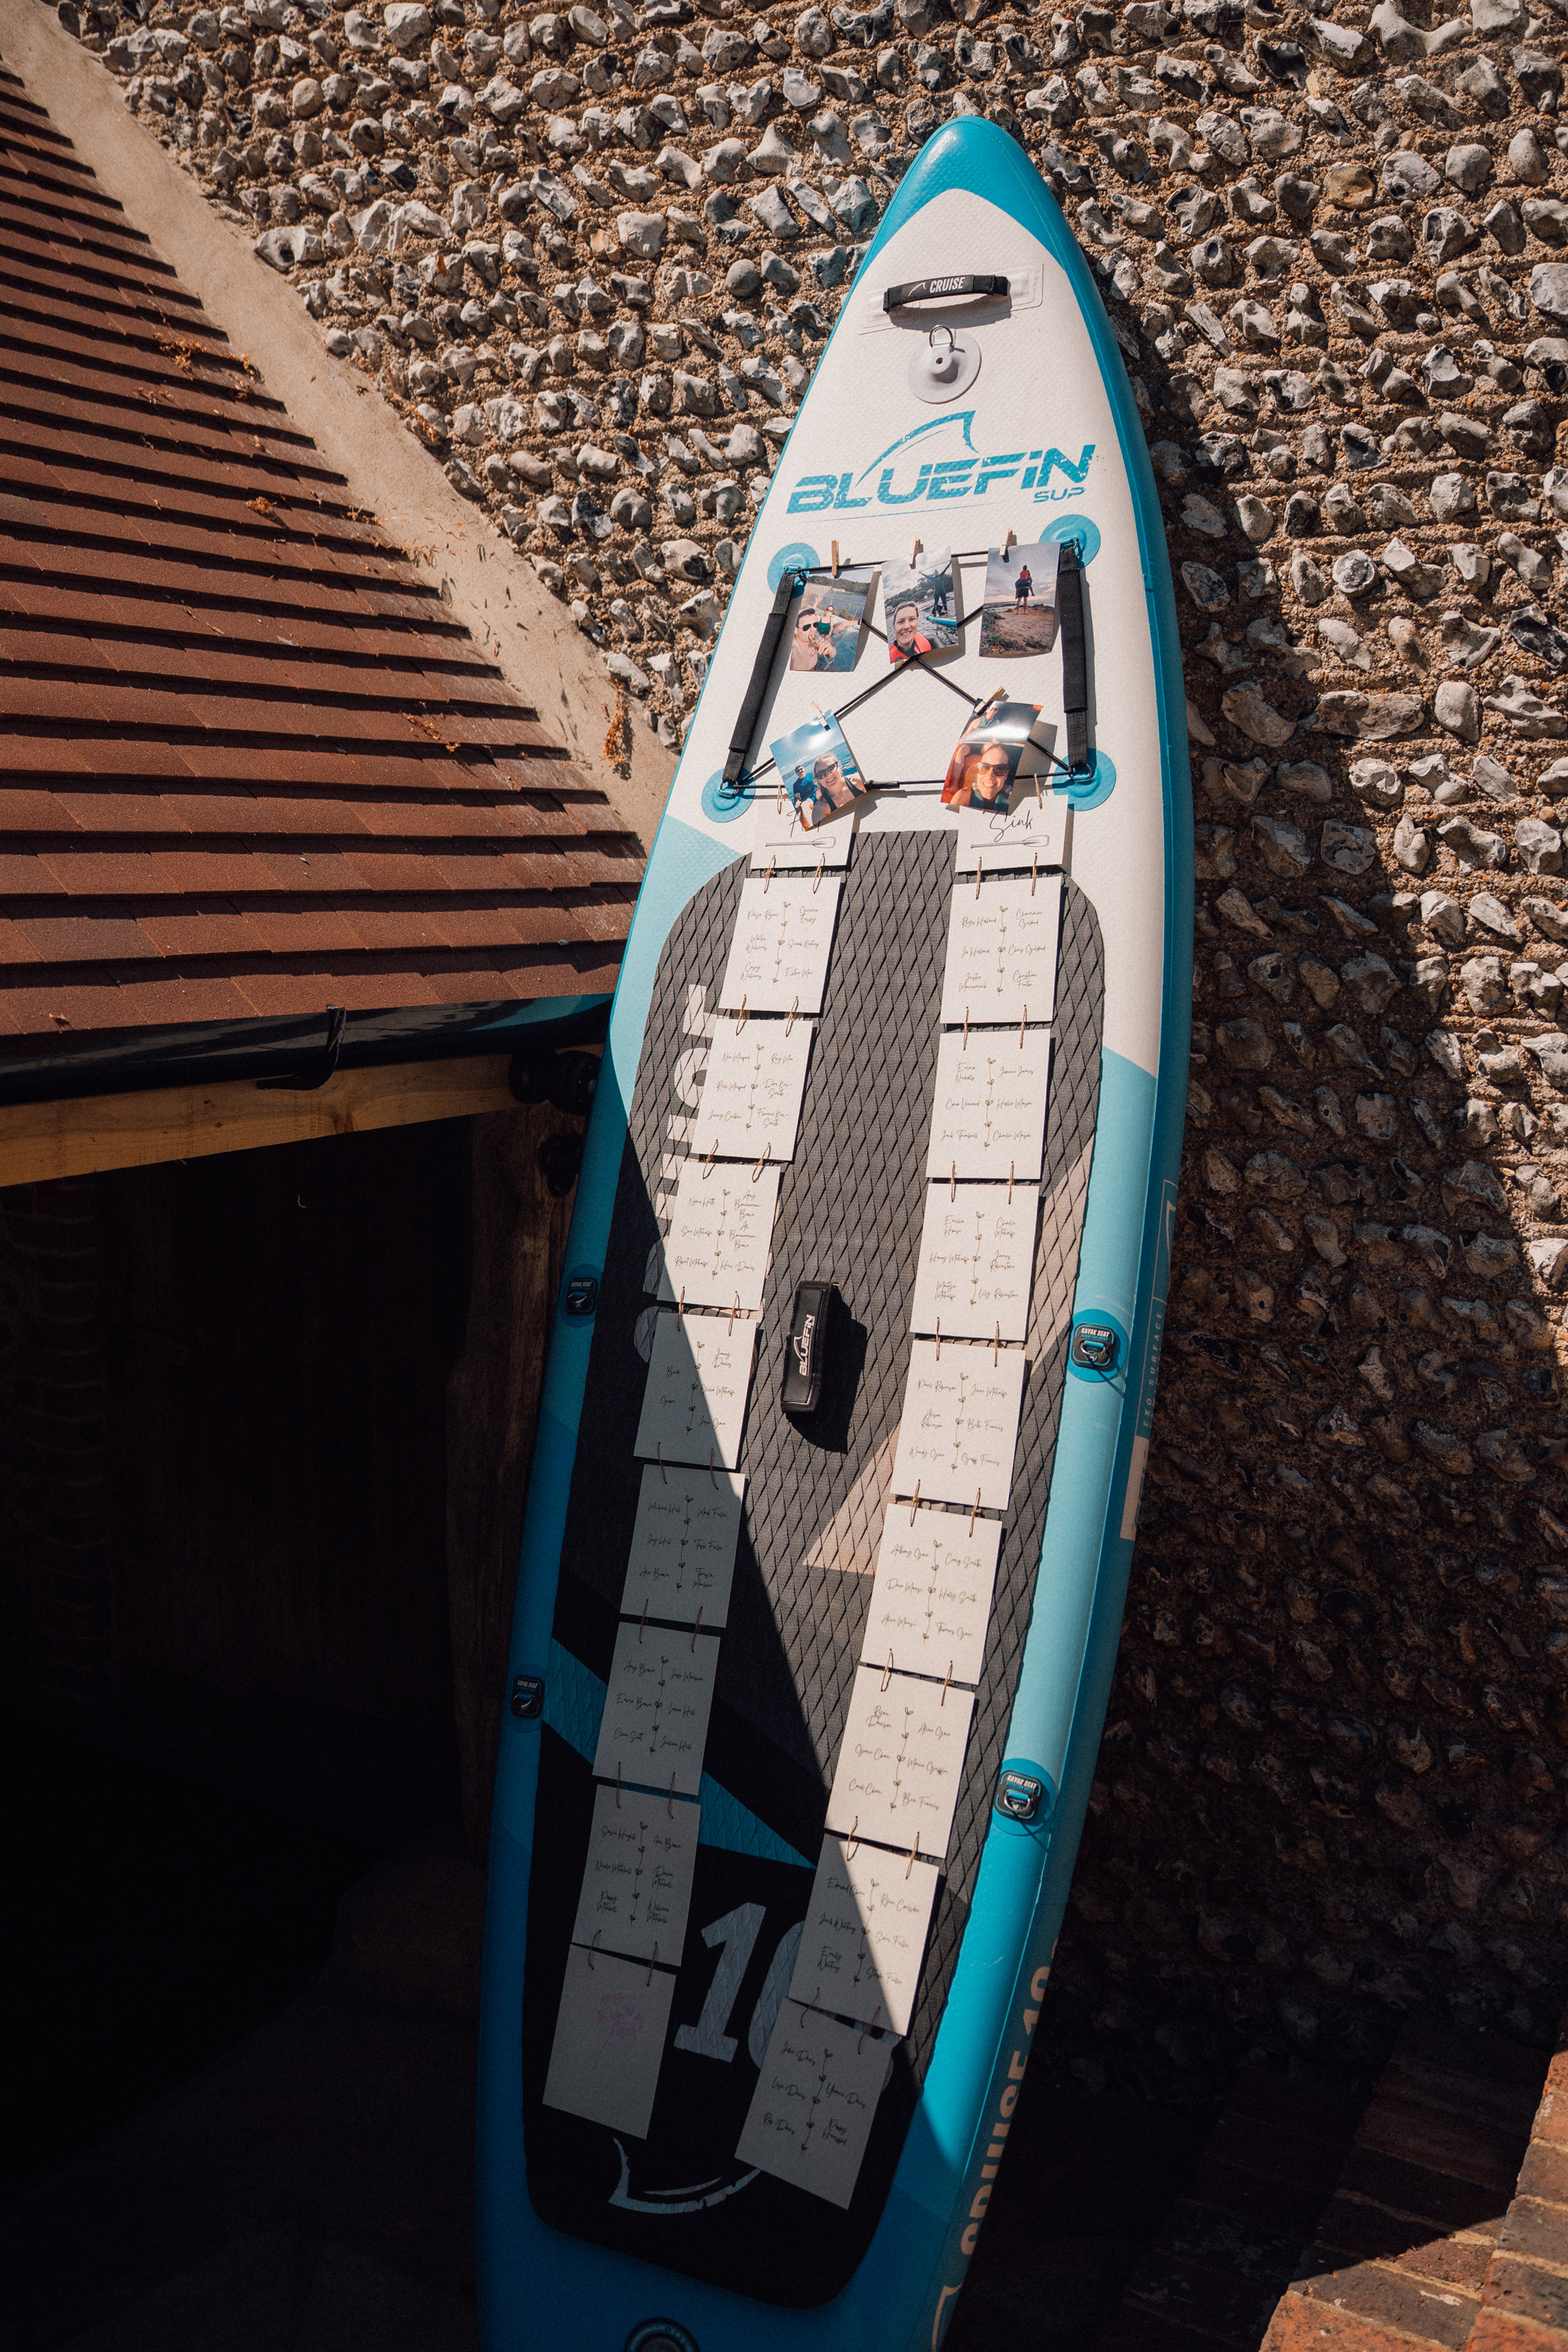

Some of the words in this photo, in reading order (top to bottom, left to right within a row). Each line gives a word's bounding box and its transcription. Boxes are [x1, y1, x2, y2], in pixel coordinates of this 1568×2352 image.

[929, 277, 965, 294] CRUISE
[786, 445, 1095, 514] BLUEFIN
[1033, 486, 1086, 504] SUP
[989, 810, 1034, 843] Sink
[977, 916, 996, 927] Holland
[970, 947, 989, 957] Holland
[1008, 945, 1024, 956] Chris
[956, 1062, 975, 1073] Emma
[941, 1130, 953, 1141] Jack
[799, 1314, 815, 1377] BLUEFIN
[666, 1366, 681, 1378] Bride
[1142, 1397, 1152, 1427] EXO
[1148, 1311, 1163, 1386] SURFACE
[660, 1396, 676, 1407] Groom
[963, 1556, 982, 1568] Smith
[959, 1592, 977, 1604] Smith
[1007, 1775, 1024, 1785] KAYAK
[1024, 1780, 1038, 1790] SEAT
